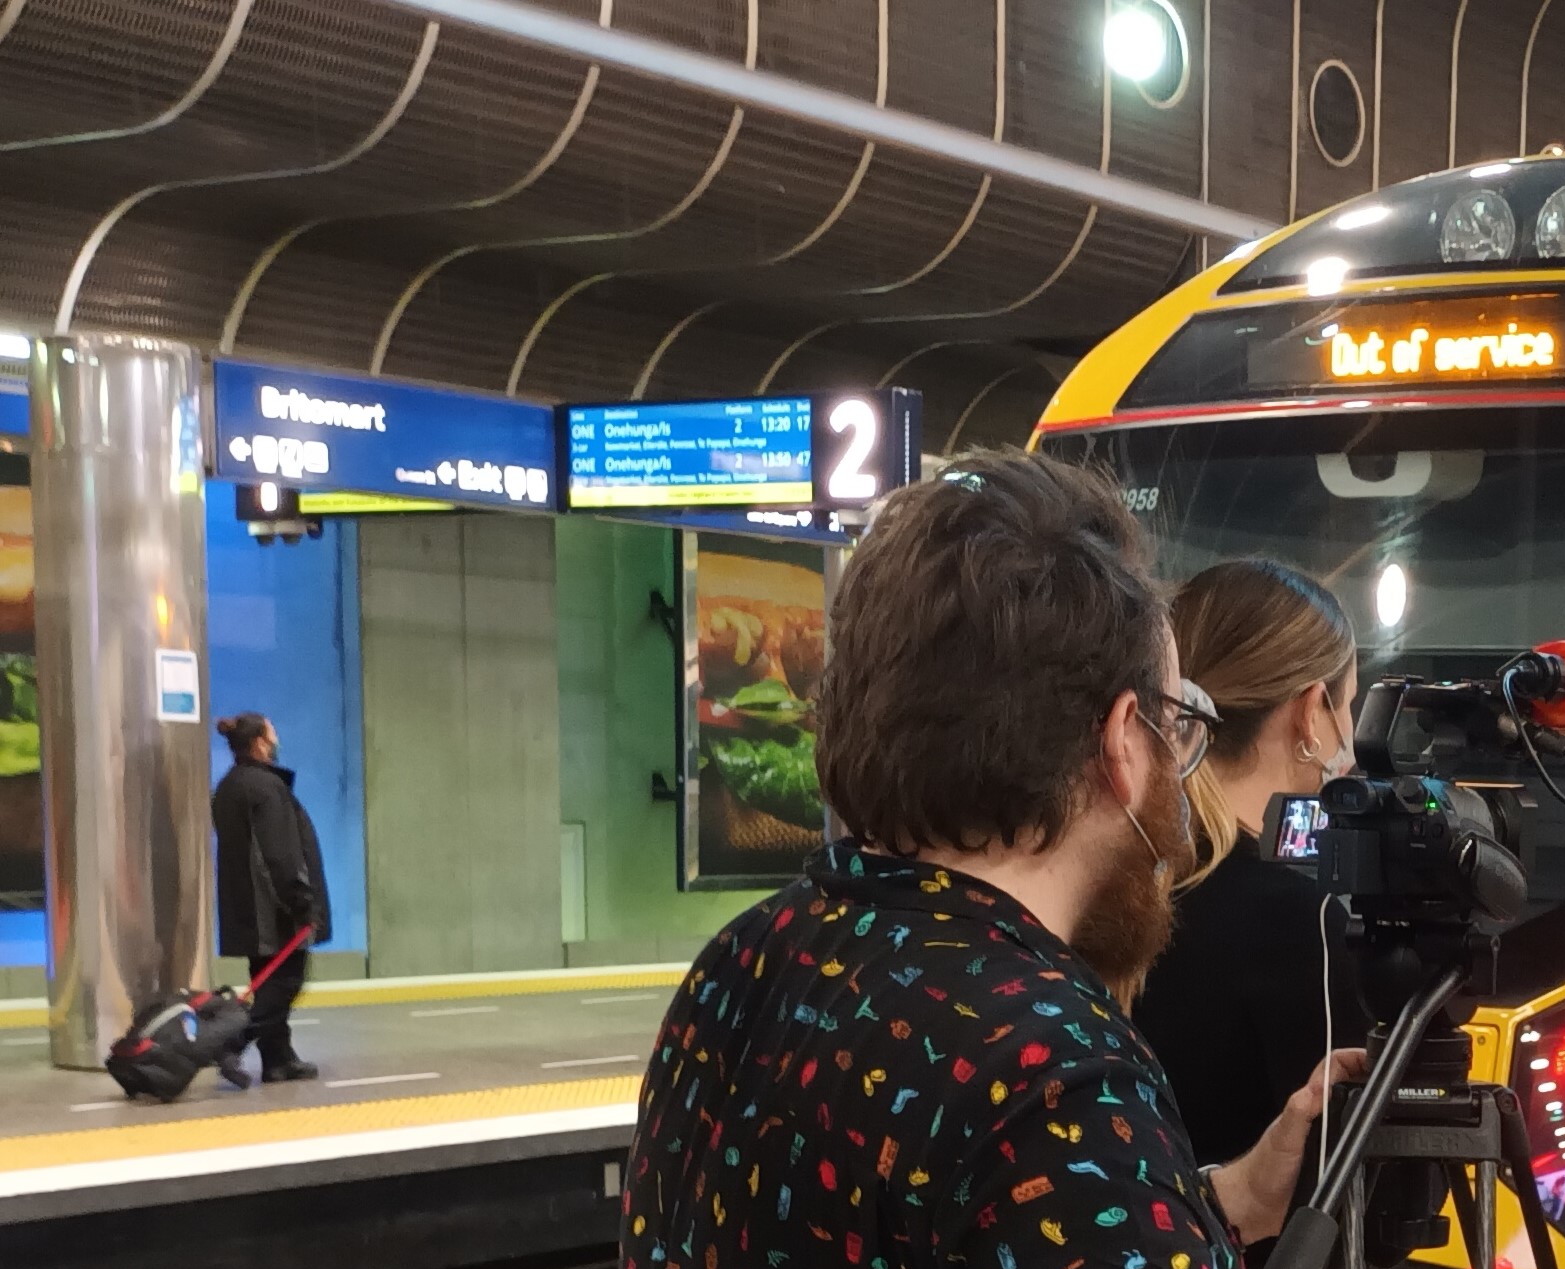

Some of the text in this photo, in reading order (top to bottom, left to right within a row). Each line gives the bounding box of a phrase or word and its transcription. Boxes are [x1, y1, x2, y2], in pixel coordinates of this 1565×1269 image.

[1331, 323, 1555, 377] Out of service
[828, 399, 877, 499] 2
[1397, 1088, 1439, 1096] MILLER
